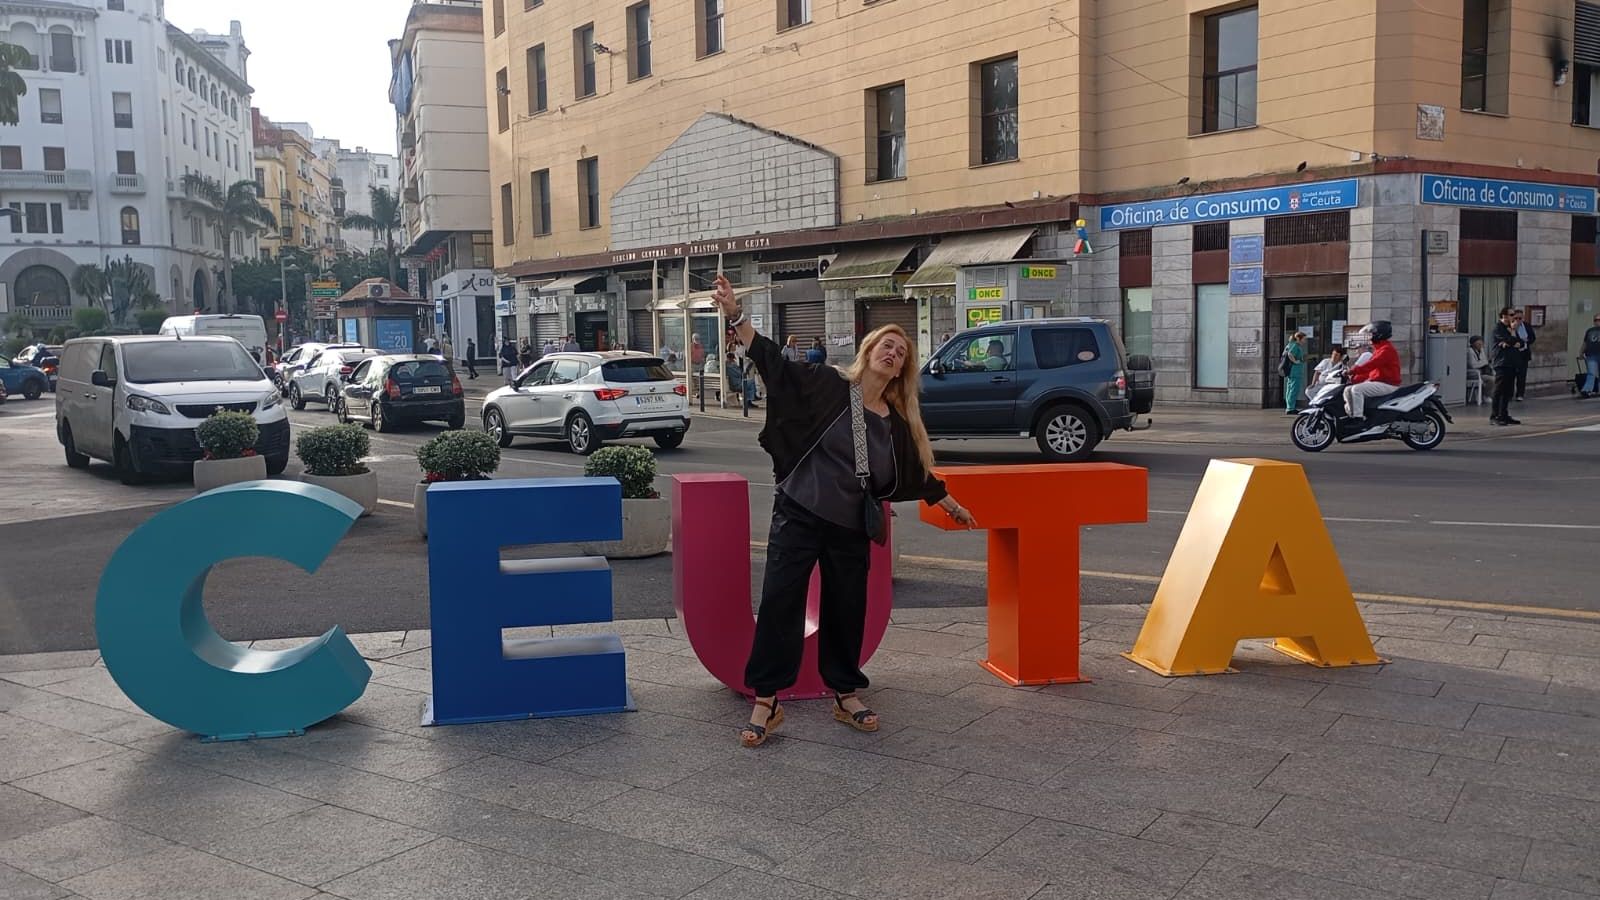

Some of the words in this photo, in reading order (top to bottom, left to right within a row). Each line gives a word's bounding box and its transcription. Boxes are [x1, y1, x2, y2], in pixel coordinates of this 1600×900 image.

[1432, 180, 1476, 202] Oficina
[1480, 183, 1495, 203] de
[1500, 186, 1554, 207] Consumo
[1310, 195, 1341, 206] Ceuta
[1570, 199, 1587, 208] Ceuta
[1111, 207, 1164, 226] Oficina
[1169, 203, 1189, 220] de
[1195, 196, 1280, 218] Consumo
[674, 247, 682, 255] DE
[727, 241, 736, 250] DE
[1032, 269, 1055, 277] ONCE
[979, 289, 1001, 298] ONCE
[95, 458, 1389, 742] CEUTA
